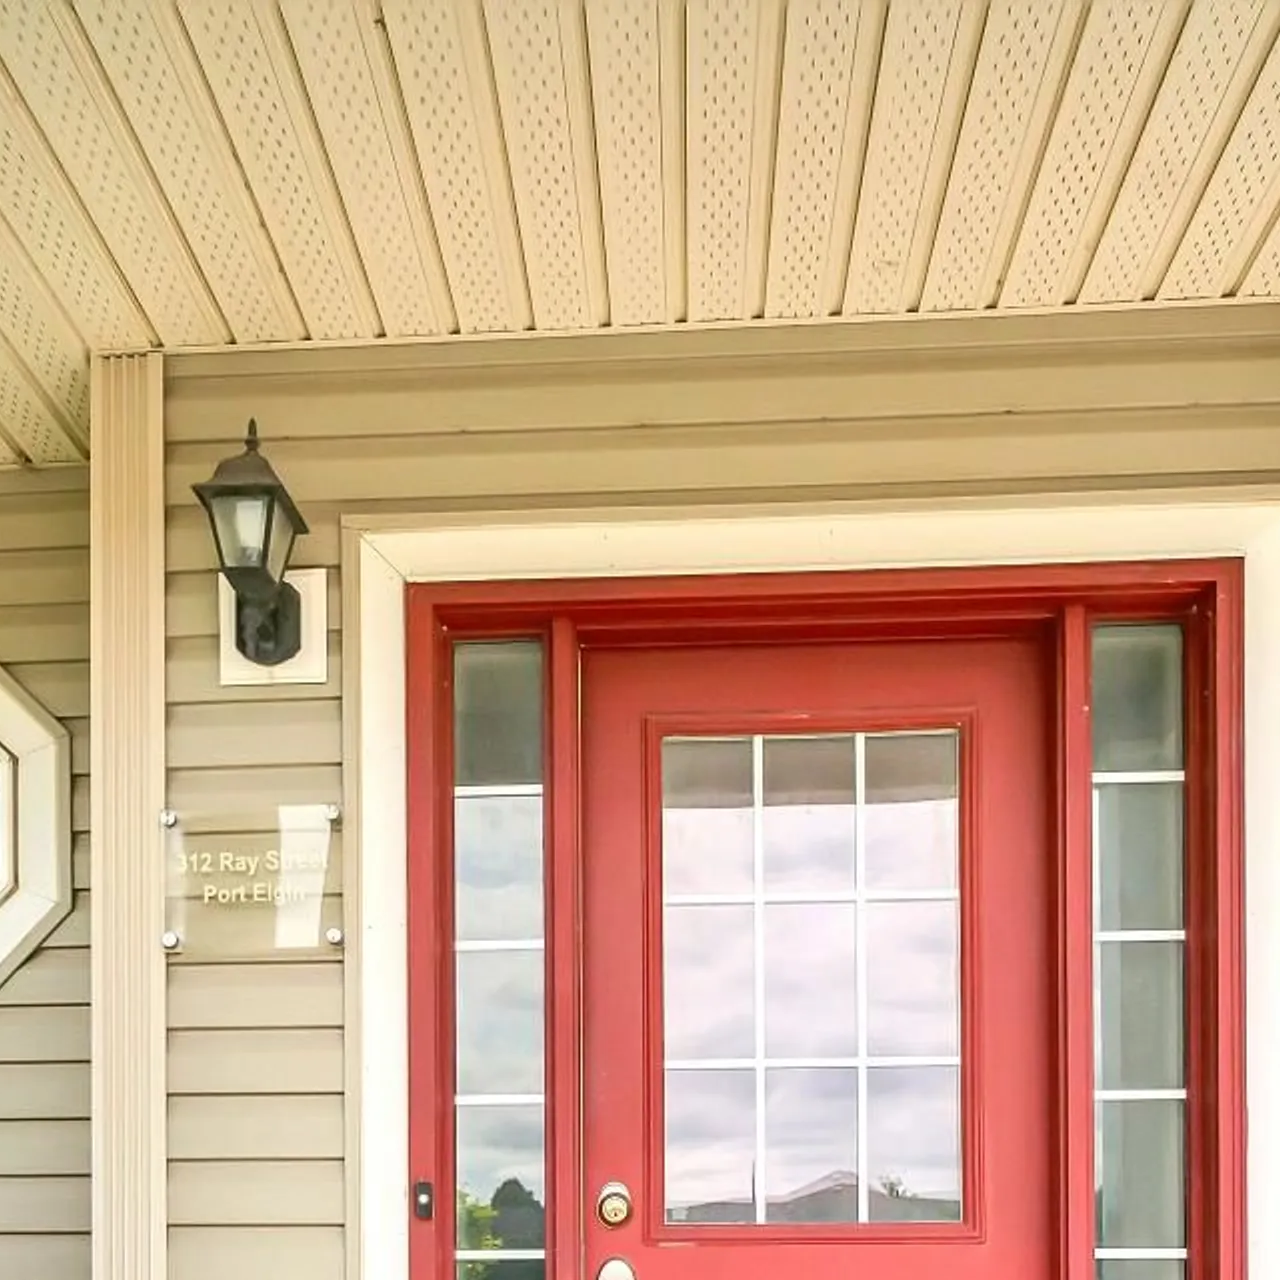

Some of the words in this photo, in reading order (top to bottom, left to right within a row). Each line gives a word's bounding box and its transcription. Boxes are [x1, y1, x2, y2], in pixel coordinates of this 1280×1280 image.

[219, 851, 259, 875] Ray
[203, 884, 247, 904] Port
[253, 881, 306, 906] Elgin
